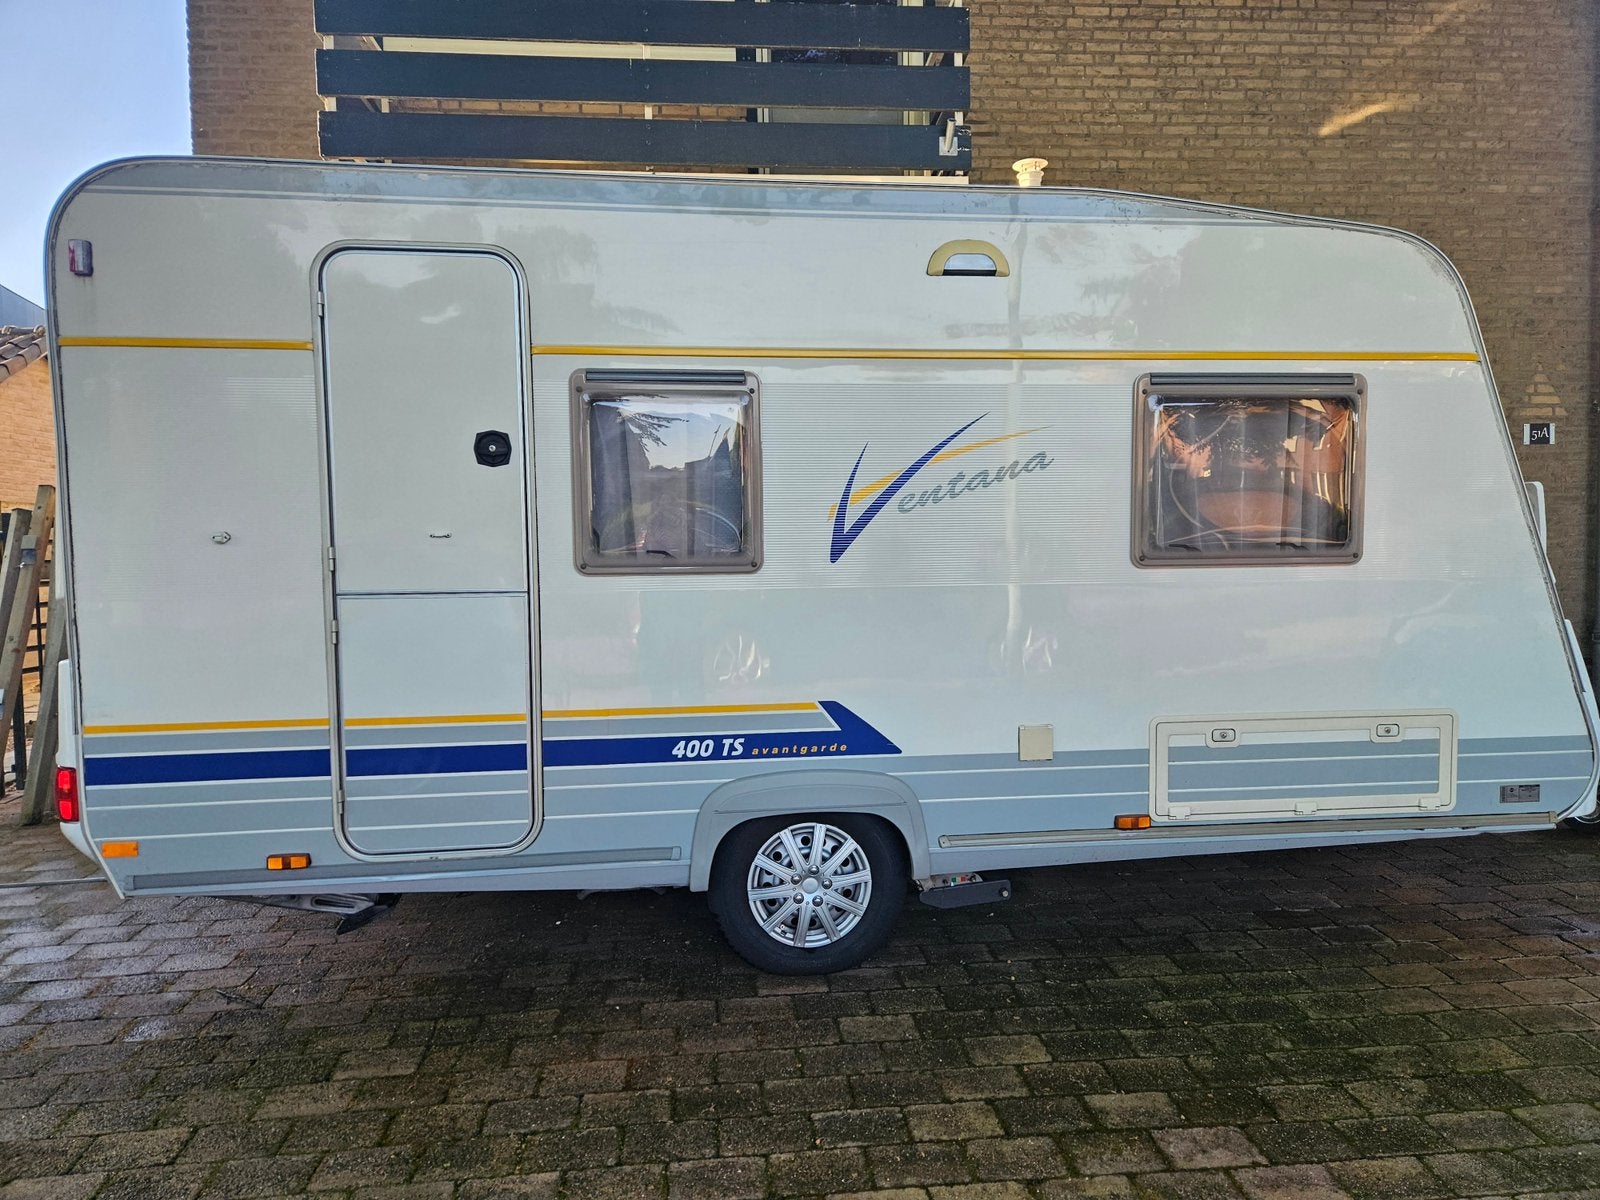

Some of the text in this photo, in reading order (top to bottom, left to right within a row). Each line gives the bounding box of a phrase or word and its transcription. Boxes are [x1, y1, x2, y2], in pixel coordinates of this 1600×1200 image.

[1531, 427, 1549, 441] 51A
[830, 411, 1055, 563] Ventana
[672, 738, 847, 758] 400 TS avantgarde
